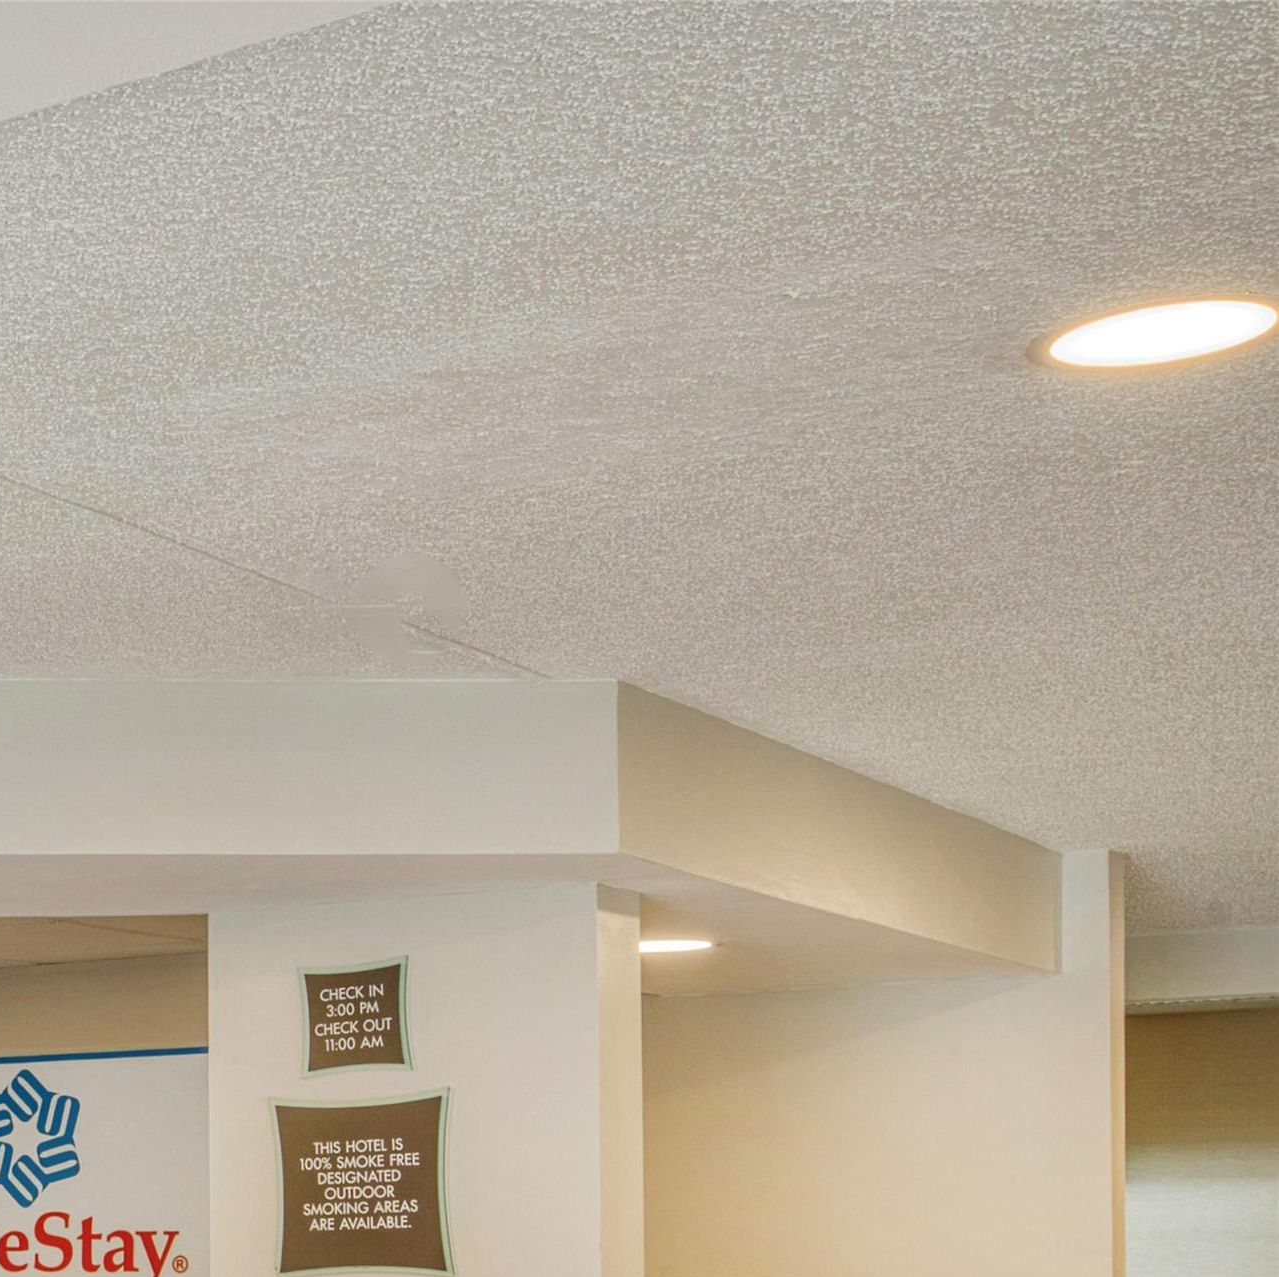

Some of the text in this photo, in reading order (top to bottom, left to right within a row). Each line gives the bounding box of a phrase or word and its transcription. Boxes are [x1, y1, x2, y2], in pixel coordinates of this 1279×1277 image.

[320, 983, 384, 1001] CHECK IN
[326, 1001, 379, 1018] 3:00 PM
[314, 1017, 393, 1037] CHECK OUT
[325, 1035, 384, 1052] 11:00 AM
[313, 1138, 403, 1155] THIS HOTEL IS
[299, 1152, 420, 1171] 100% SMOKE FREE
[318, 1169, 402, 1185] DESIGNATED
[324, 1185, 395, 1200] OUTDOOR
[303, 1200, 419, 1217] SMOKING AREAS
[309, 1215, 412, 1232] ARE AVAILABLE.
